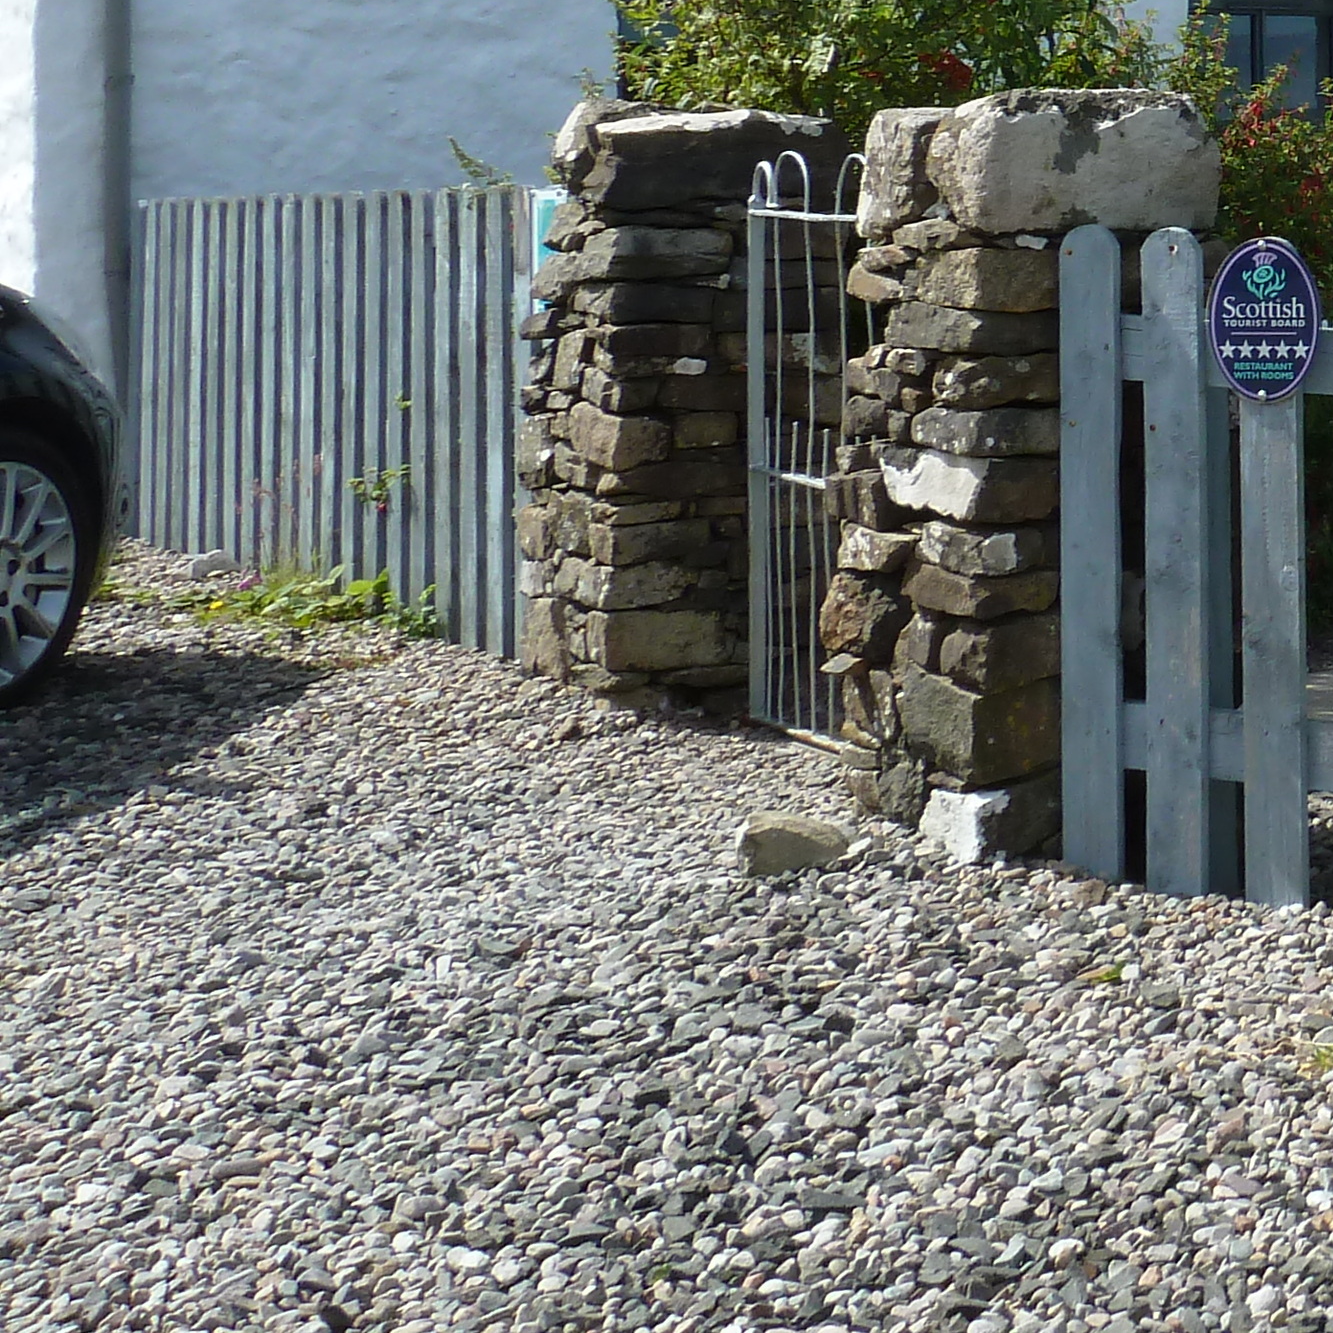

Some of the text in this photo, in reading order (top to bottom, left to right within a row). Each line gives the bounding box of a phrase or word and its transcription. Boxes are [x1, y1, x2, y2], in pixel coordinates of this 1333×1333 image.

[1222, 296, 1305, 318] Scottish
[1224, 319, 1306, 327] TOURIST BOARD
[1234, 362, 1293, 370] RESTAURANT
